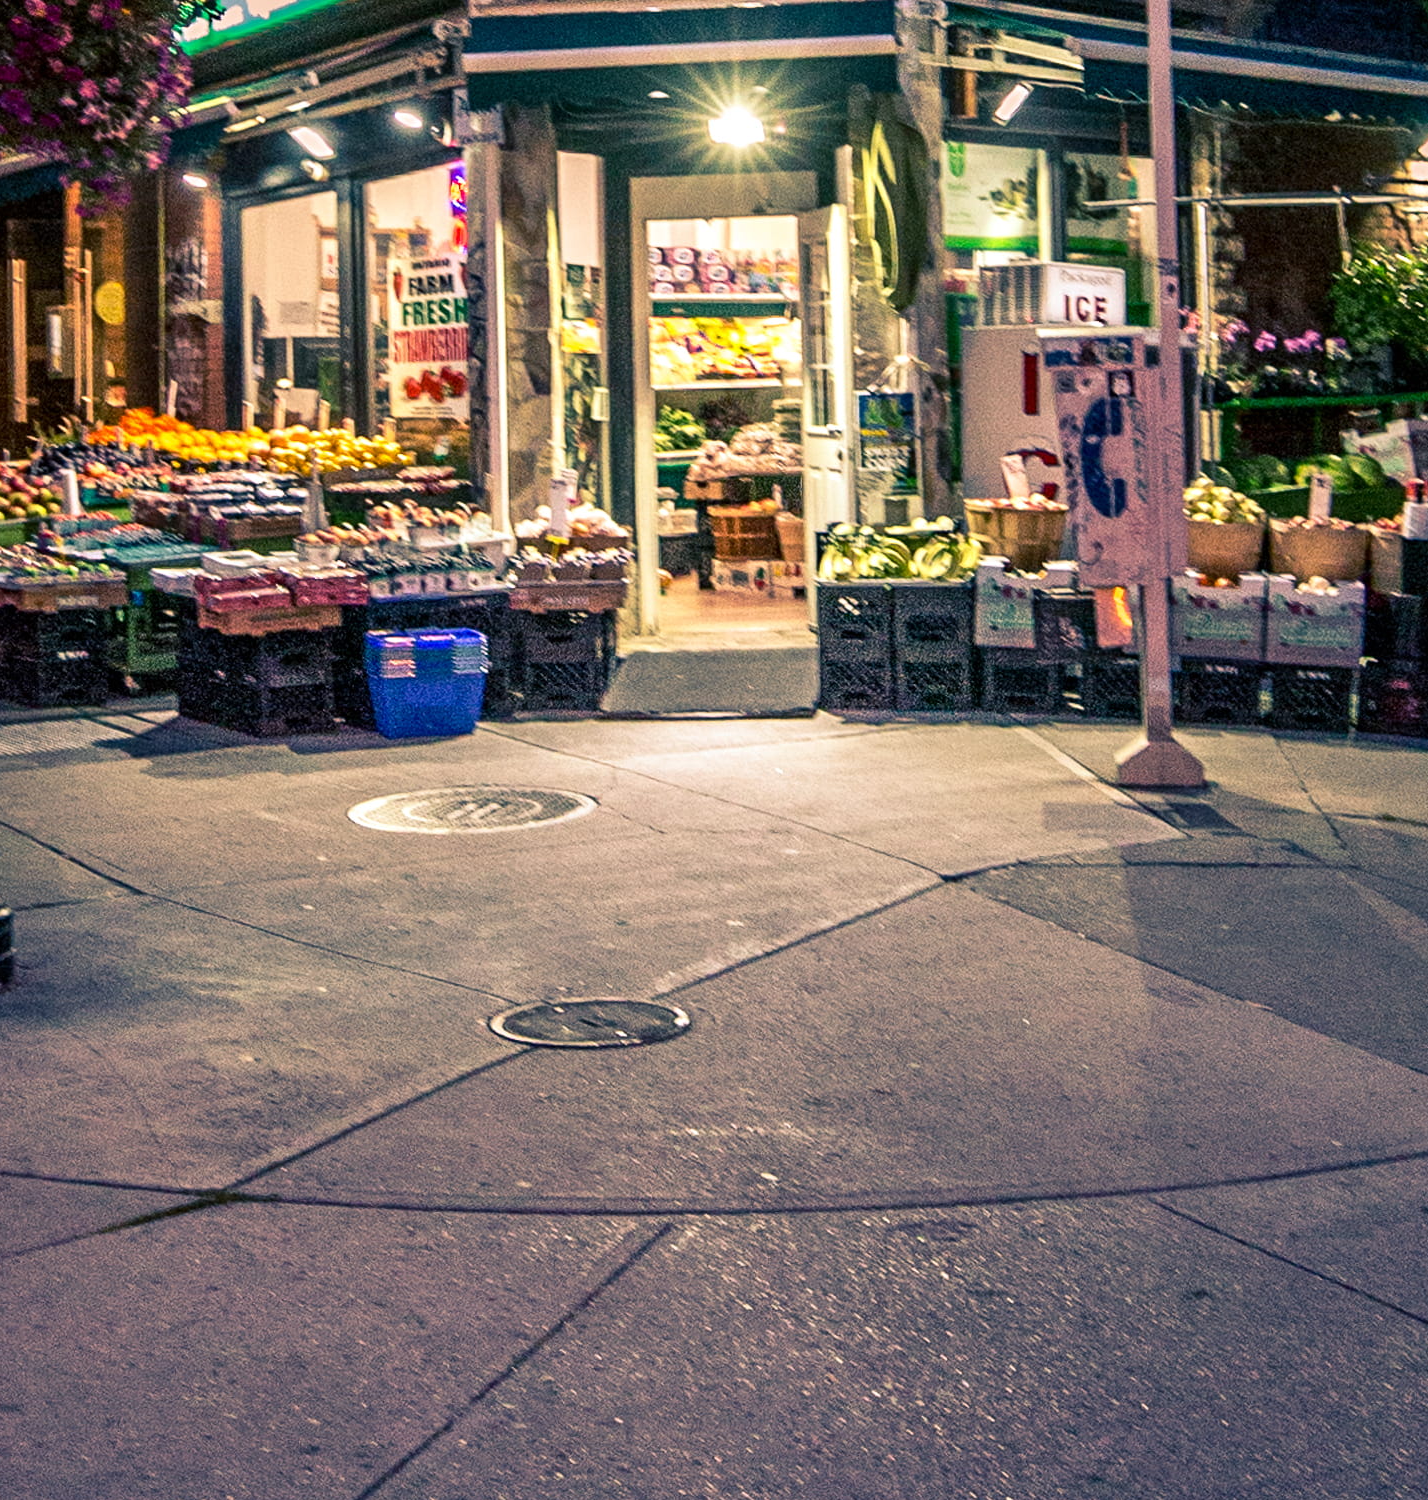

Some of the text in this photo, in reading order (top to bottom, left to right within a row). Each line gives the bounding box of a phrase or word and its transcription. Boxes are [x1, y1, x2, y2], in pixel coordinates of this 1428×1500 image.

[408, 273, 455, 296] FARM
[402, 297, 468, 326] FRESH
[1064, 294, 1109, 328] ICE
